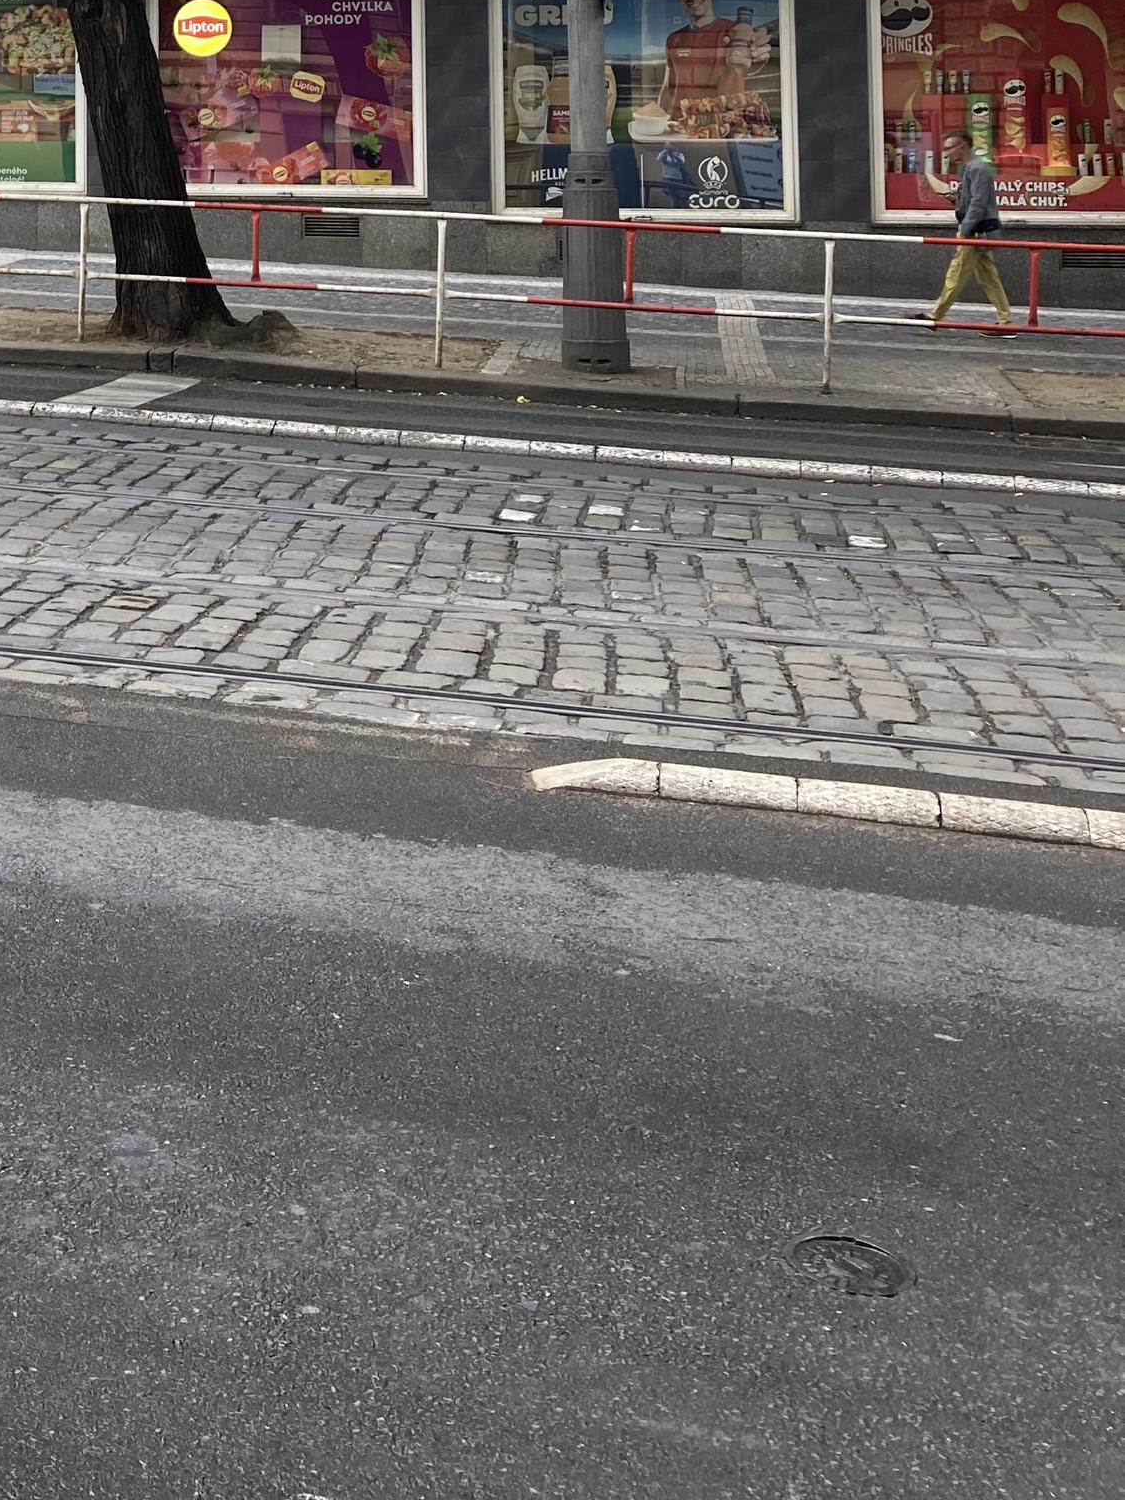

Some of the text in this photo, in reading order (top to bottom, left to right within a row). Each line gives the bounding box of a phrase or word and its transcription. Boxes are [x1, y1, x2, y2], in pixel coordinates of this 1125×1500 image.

[332, 1, 393, 12] CHVILKA
[305, 14, 362, 25] POHODY
[181, 20, 224, 35] Lipton
[293, 80, 321, 94] Lipton
[1025, 181, 1070, 194] CHIPS,
